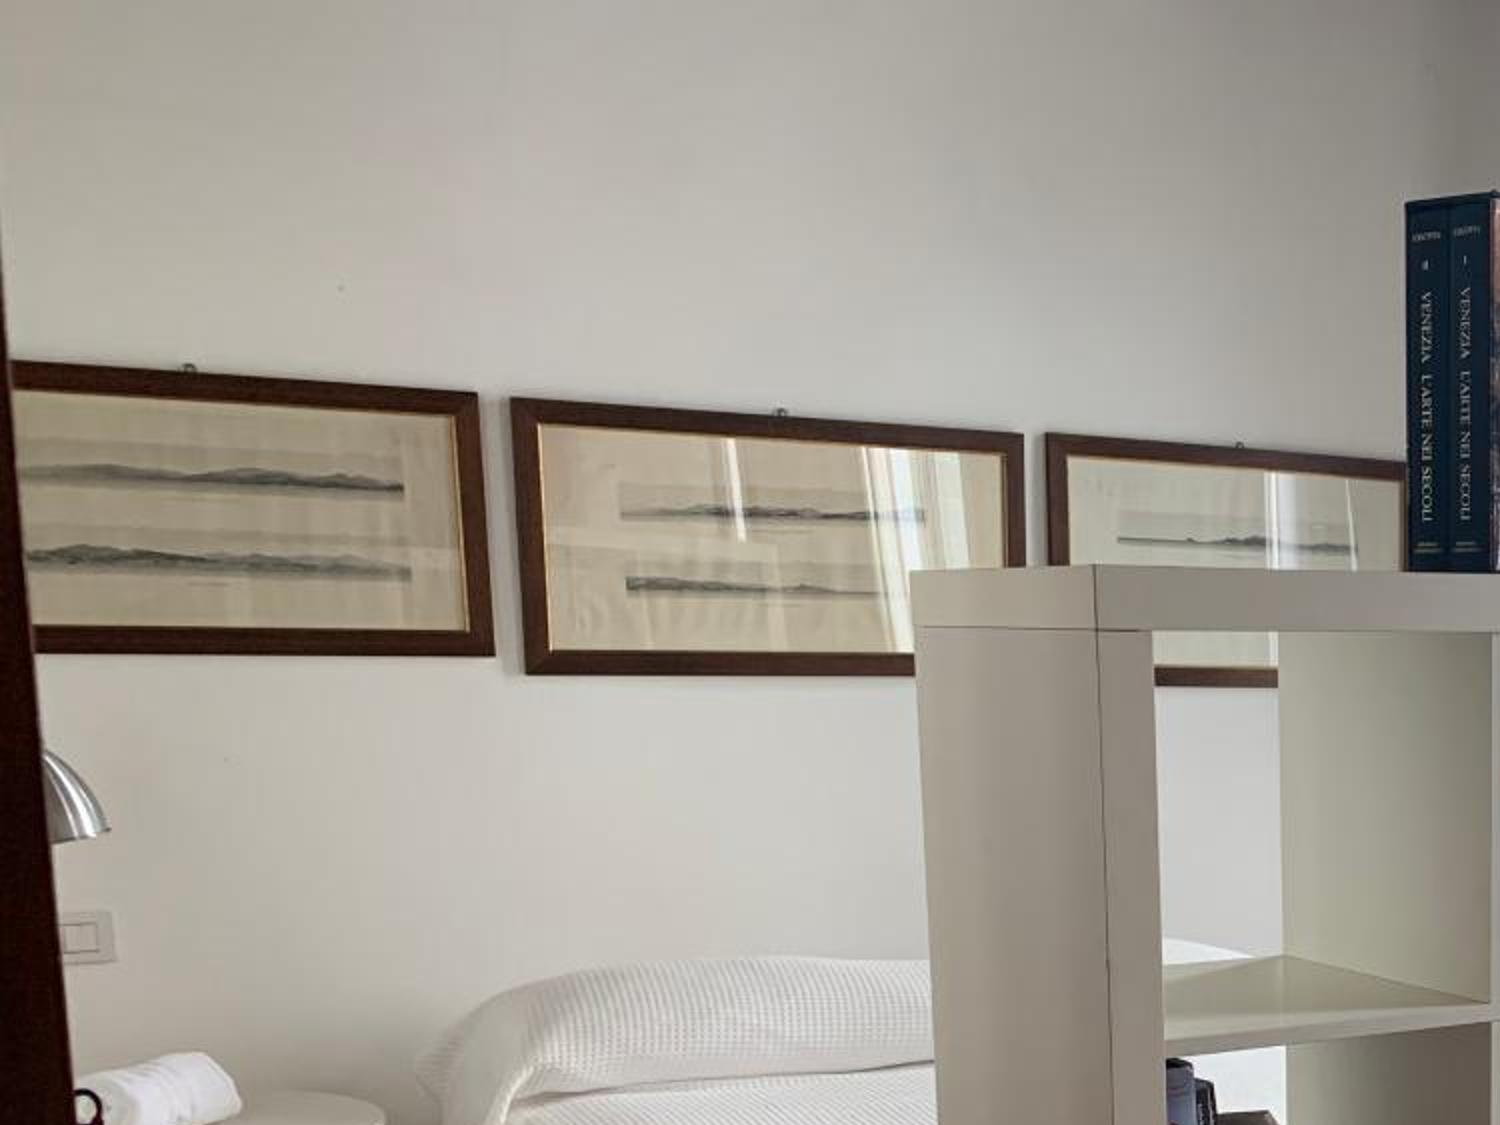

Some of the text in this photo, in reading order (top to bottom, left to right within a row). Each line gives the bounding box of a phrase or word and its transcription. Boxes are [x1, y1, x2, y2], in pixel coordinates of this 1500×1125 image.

[1459, 287, 1472, 359] VENEZIA
[1420, 291, 1433, 523] VENEZIA L'ARTE NEI SECOLI
[1459, 430, 1472, 459] NEI
[1459, 462, 1472, 521] SECOLI
